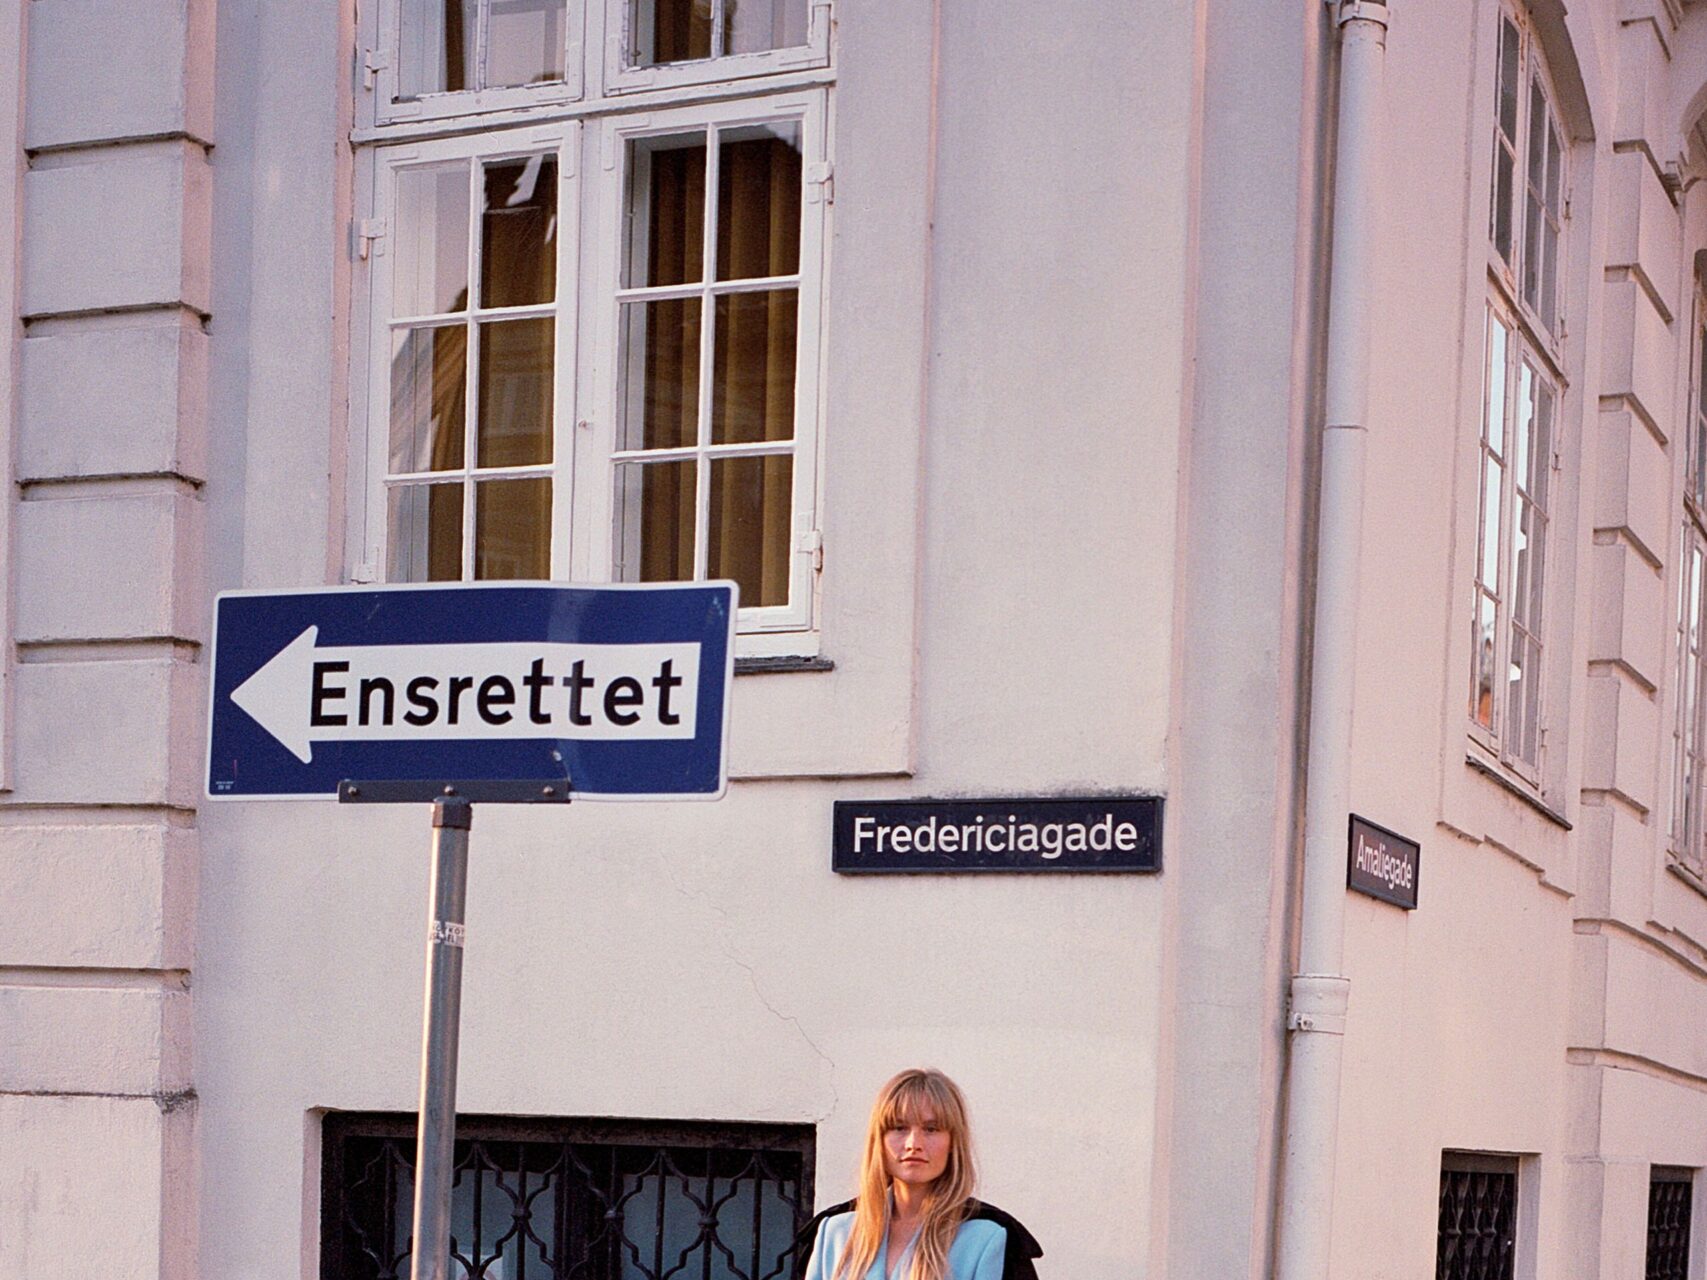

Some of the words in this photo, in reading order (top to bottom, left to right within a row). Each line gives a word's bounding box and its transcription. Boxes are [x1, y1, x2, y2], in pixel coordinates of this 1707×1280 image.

[309, 657, 682, 727] Ensrettet
[853, 813, 1138, 859] Fredericiagade
[1356, 834, 1412, 890] Amaliegade
